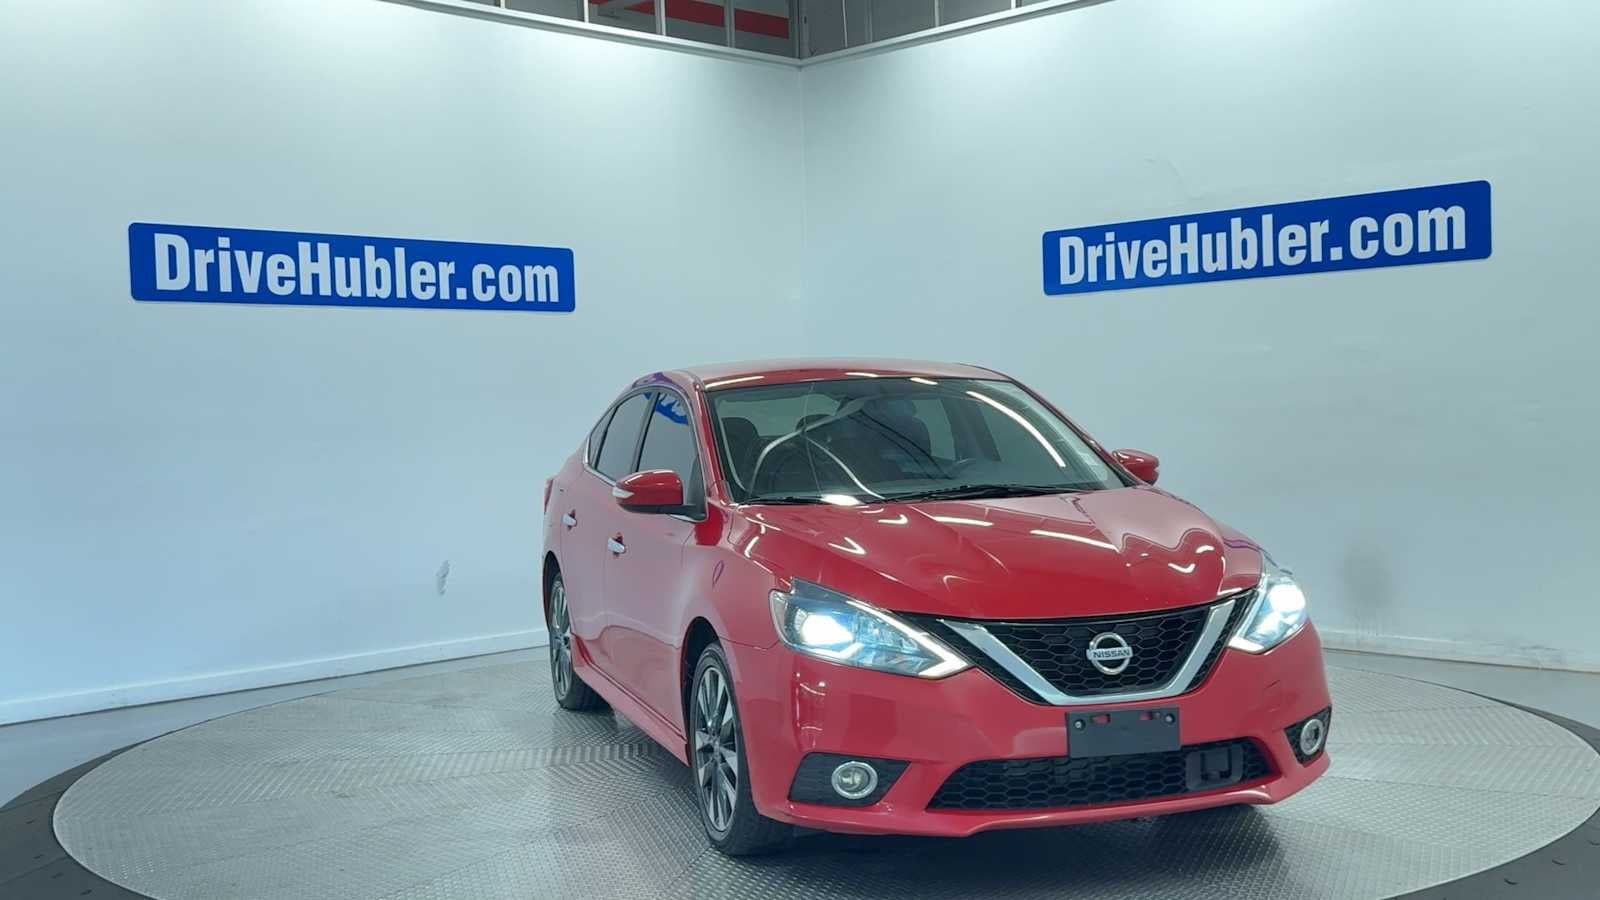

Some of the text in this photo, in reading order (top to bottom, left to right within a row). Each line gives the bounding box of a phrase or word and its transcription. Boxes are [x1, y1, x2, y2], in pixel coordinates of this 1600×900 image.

[154, 233, 559, 303] DriveHubler.com
[1059, 204, 1466, 285] DriveHubler.com
[1091, 647, 1131, 658] NISSAN
